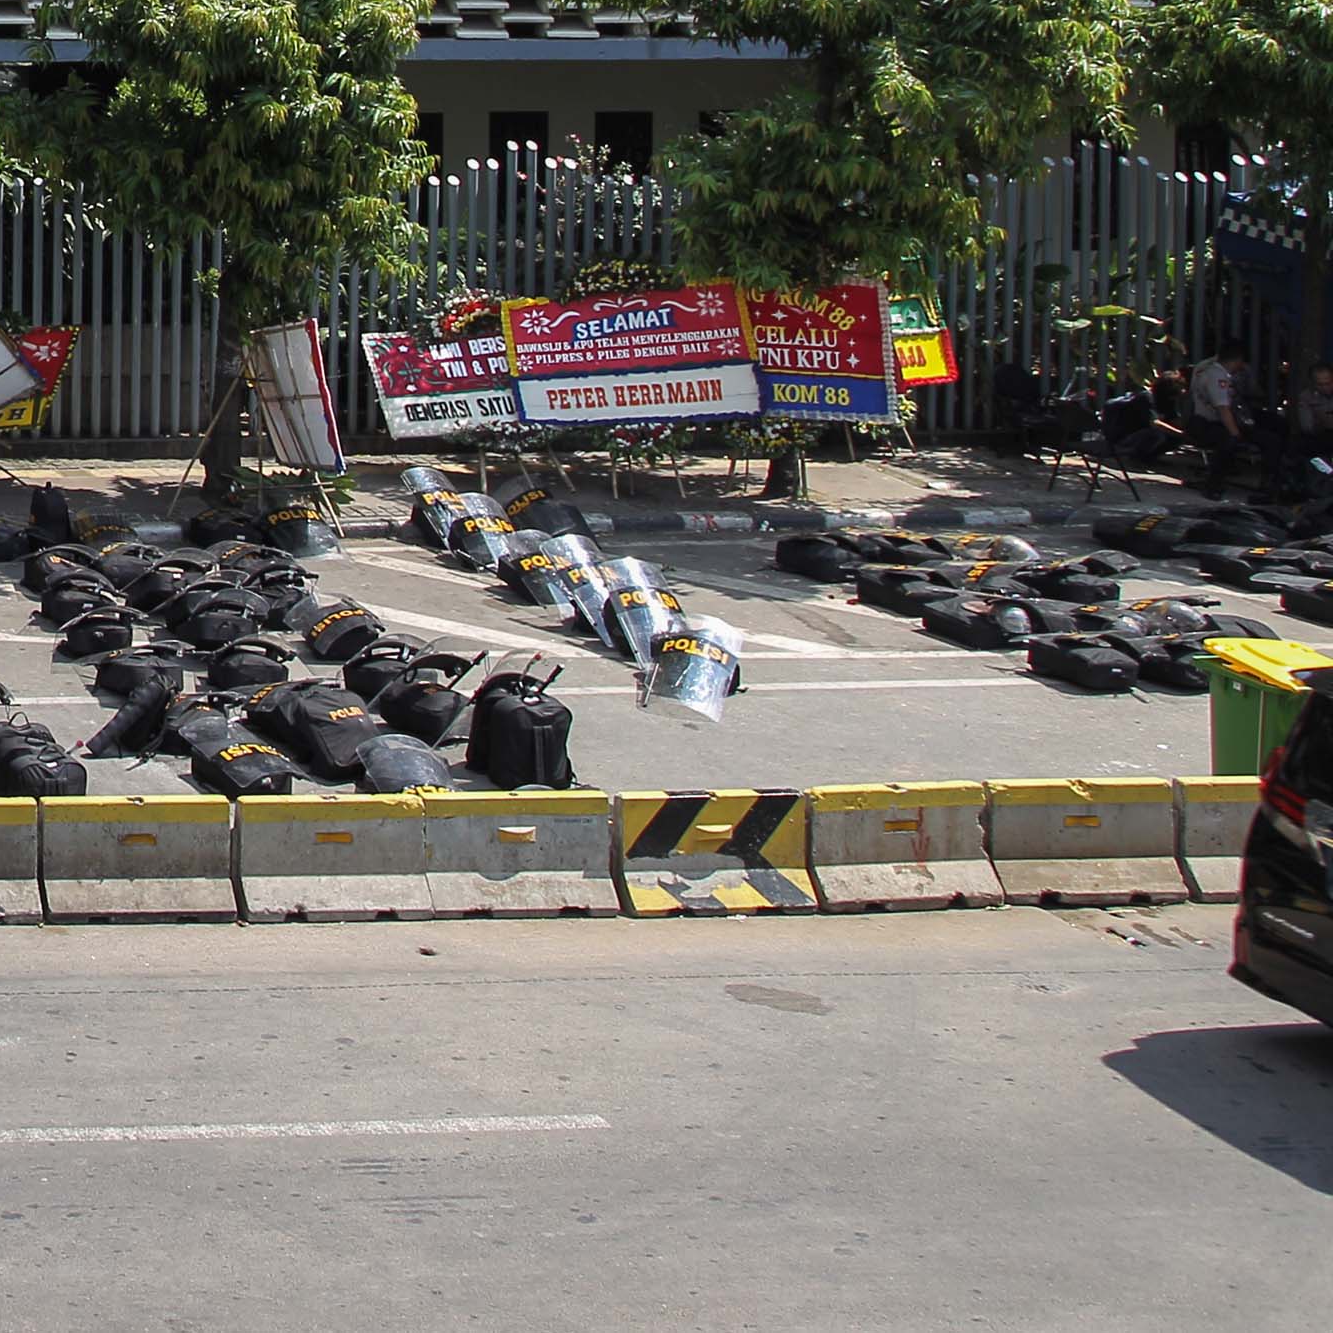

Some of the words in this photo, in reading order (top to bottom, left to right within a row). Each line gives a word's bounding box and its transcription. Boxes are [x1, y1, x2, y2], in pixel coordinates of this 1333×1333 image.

[575, 308, 672, 340] SELAMAT
[429, 342, 463, 361] KAMI
[516, 342, 563, 354] BAWASLU
[573, 338, 595, 350] KPU
[596, 336, 630, 349] TELAH
[631, 327, 741, 346] MENYELENGGARAKAN
[535, 353, 584, 365] PILPRES
[585, 352, 595, 362] &
[597, 348, 631, 361] PILEG
[634, 344, 678, 358] DENGAN
[682, 341, 711, 355] BAIK
[440, 360, 468, 379] TNI
[472, 362, 485, 376] &
[757, 347, 792, 368] TNI
[795, 349, 841, 370] KPU
[545, 386, 610, 410] PETER
[612, 378, 724, 408] HERRMANN
[404, 398, 473, 423] GENERASI
[476, 395, 516, 418] SATU
[661, 637, 731, 666] POLISI
